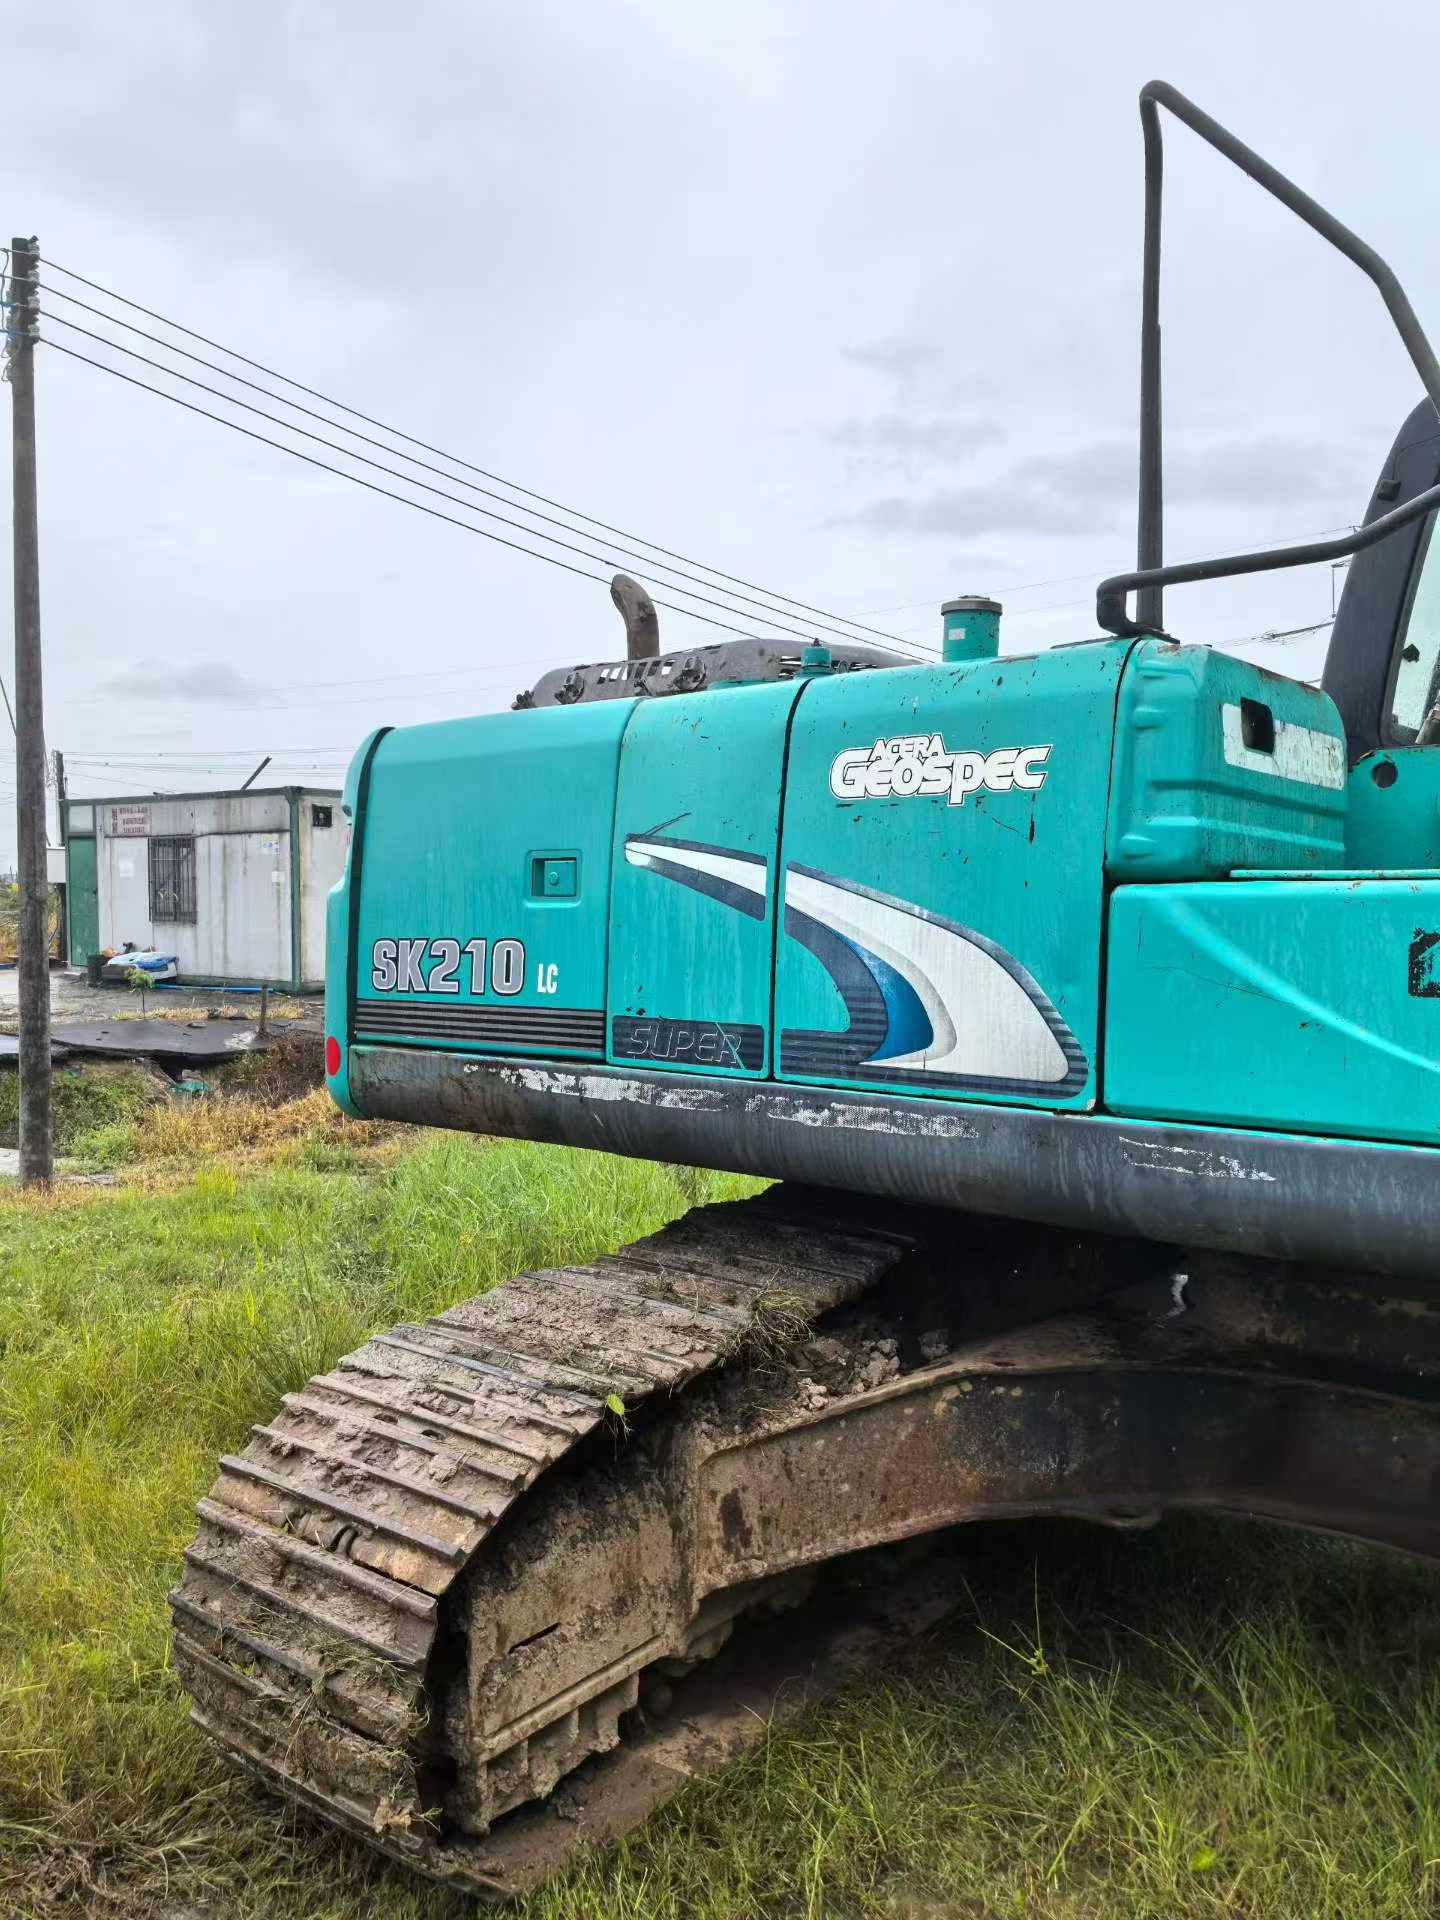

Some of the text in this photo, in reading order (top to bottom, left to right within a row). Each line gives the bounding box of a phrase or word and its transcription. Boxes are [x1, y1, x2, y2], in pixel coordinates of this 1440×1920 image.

[868, 733, 947, 762] ACERA
[371, 937, 559, 997] SK210 LC
[626, 1022, 742, 1064] SUPER
